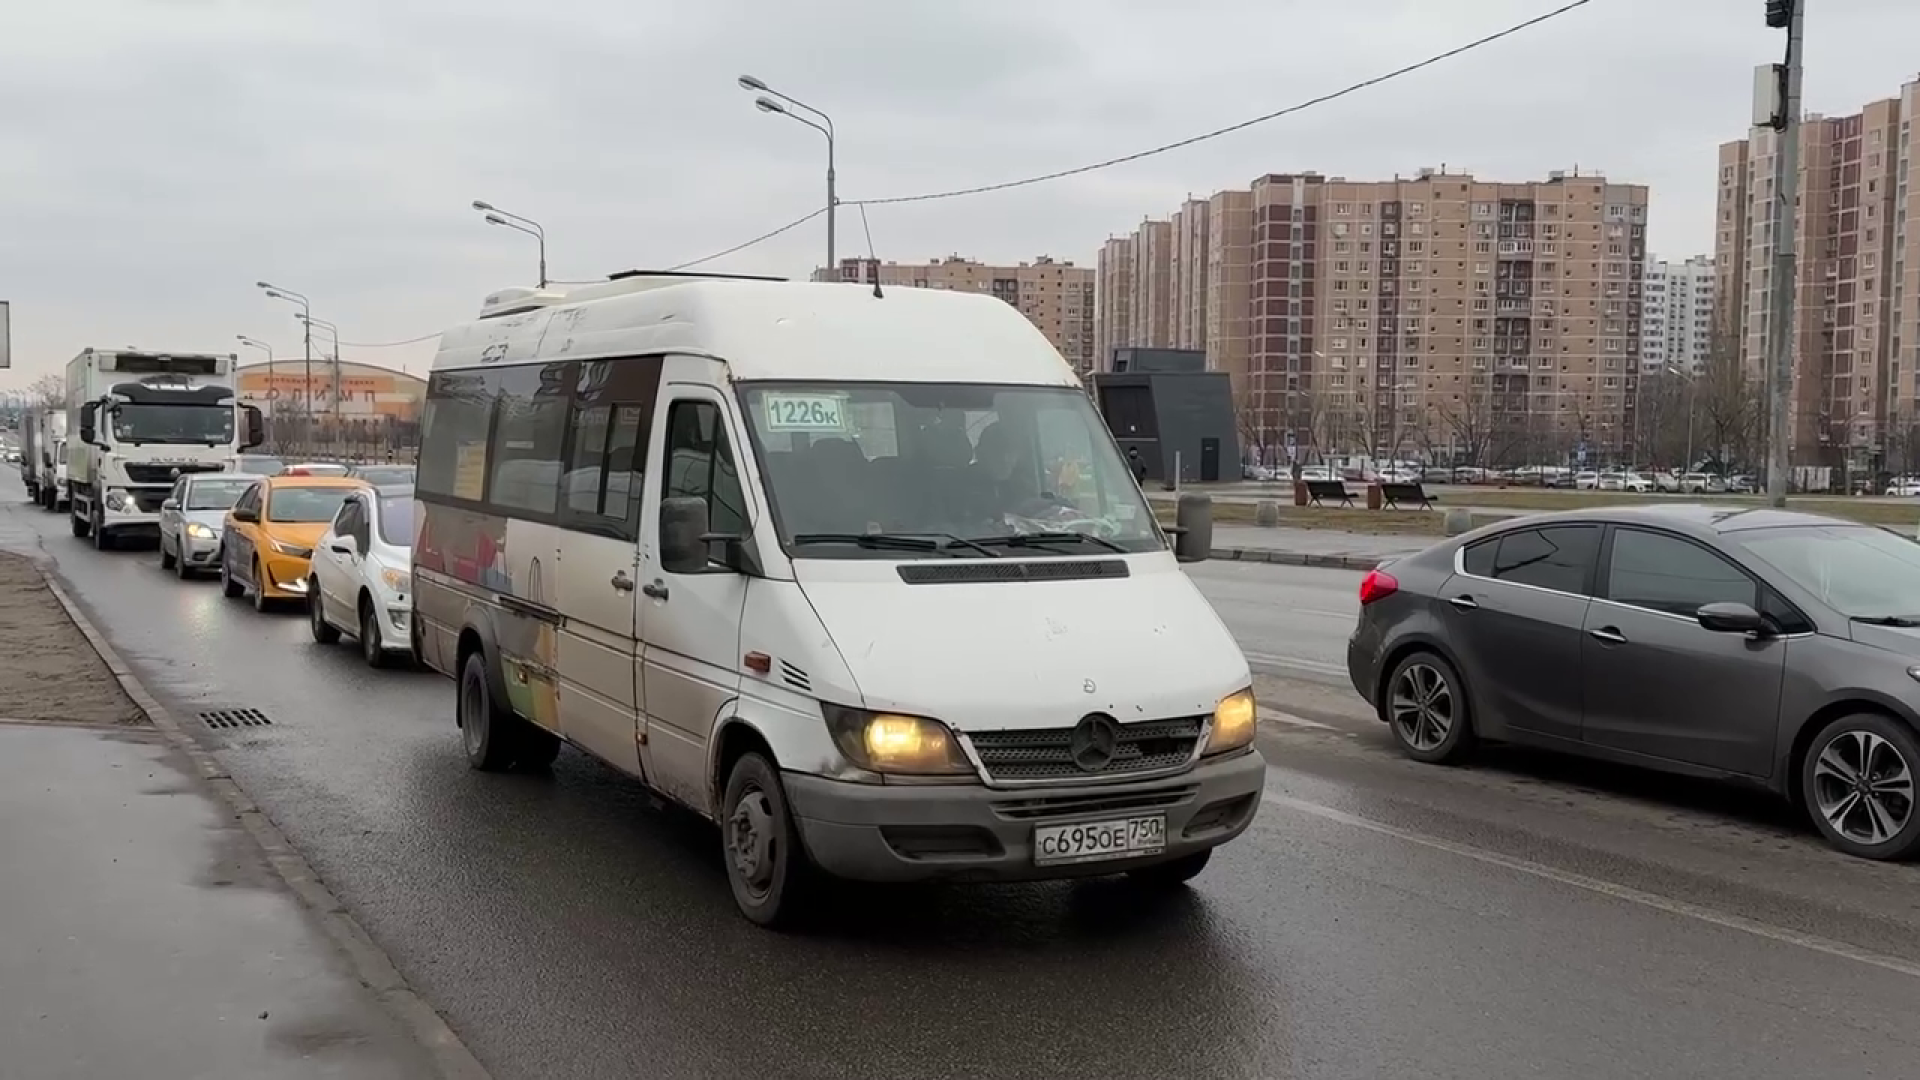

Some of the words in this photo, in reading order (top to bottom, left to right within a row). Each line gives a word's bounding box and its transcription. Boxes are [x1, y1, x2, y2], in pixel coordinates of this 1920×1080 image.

[265, 387, 376, 403] ОЛИМП
[771, 401, 837, 424] 1226к
[1129, 819, 1159, 839] 750
